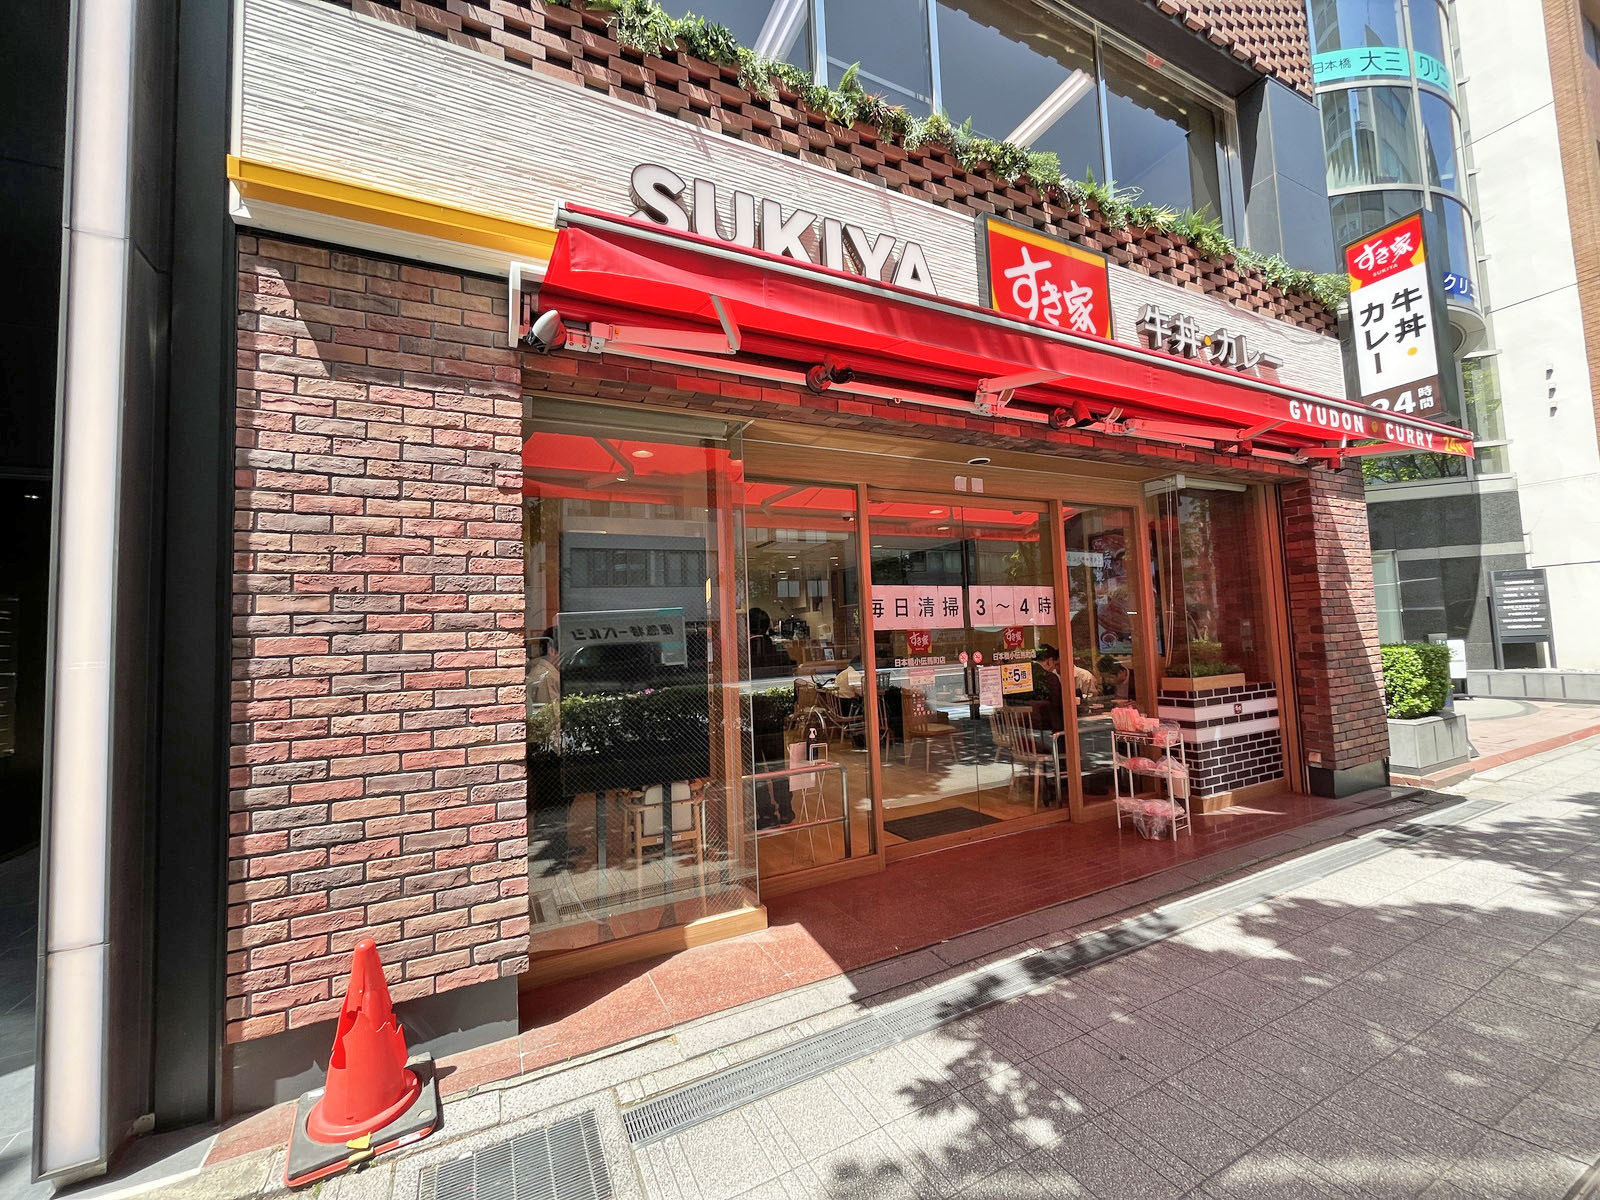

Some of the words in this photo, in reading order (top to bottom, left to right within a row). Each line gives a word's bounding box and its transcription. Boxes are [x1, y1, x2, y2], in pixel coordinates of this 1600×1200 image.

[629, 162, 939, 297] SUKIYA
[1354, 231, 1414, 272] すき家
[1004, 246, 1097, 334] すき家
[1391, 287, 1427, 344] 牛丼
[1360, 302, 1390, 374] カレー
[1289, 400, 1365, 434] GYUDON
[1385, 422, 1434, 449] CURRY
[872, 597, 959, 619] 毎日清掃
